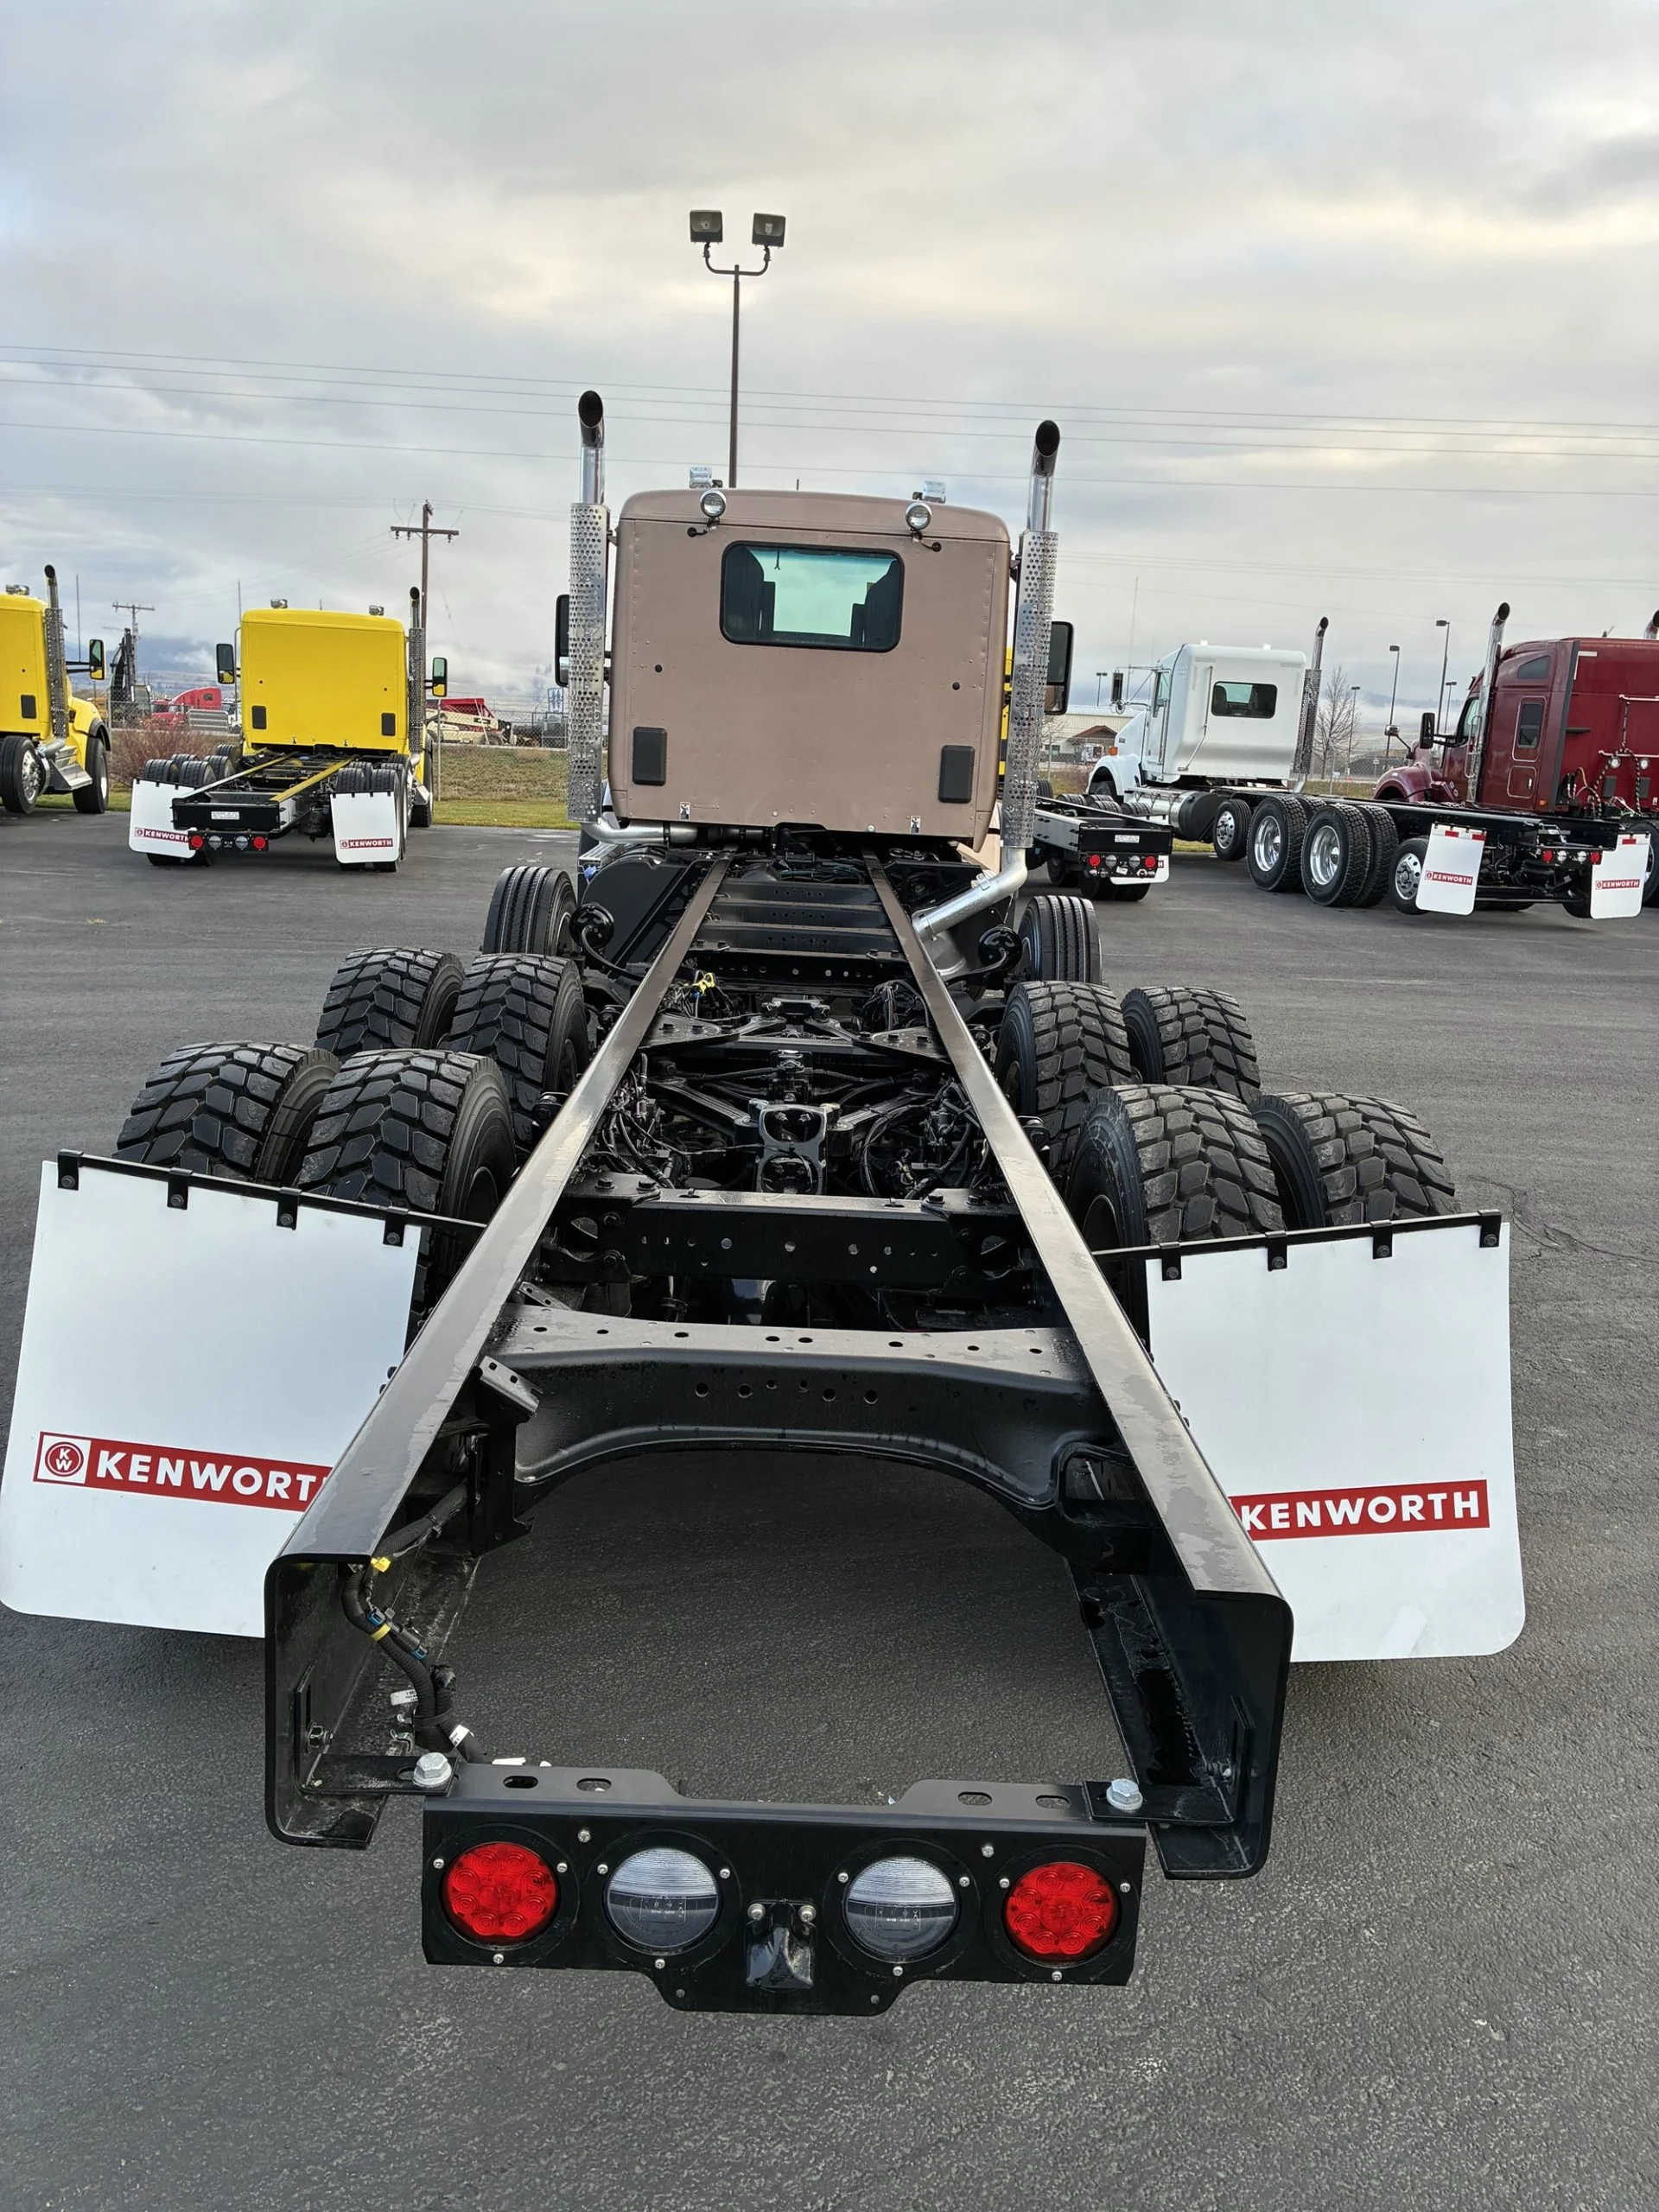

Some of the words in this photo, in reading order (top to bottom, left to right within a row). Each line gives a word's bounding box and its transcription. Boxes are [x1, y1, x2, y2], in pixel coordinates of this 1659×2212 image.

[1433, 873, 1472, 884] KENWORTH
[96, 1450, 327, 1502] KENWORT
[1241, 1491, 1480, 1530] KENWORTH
